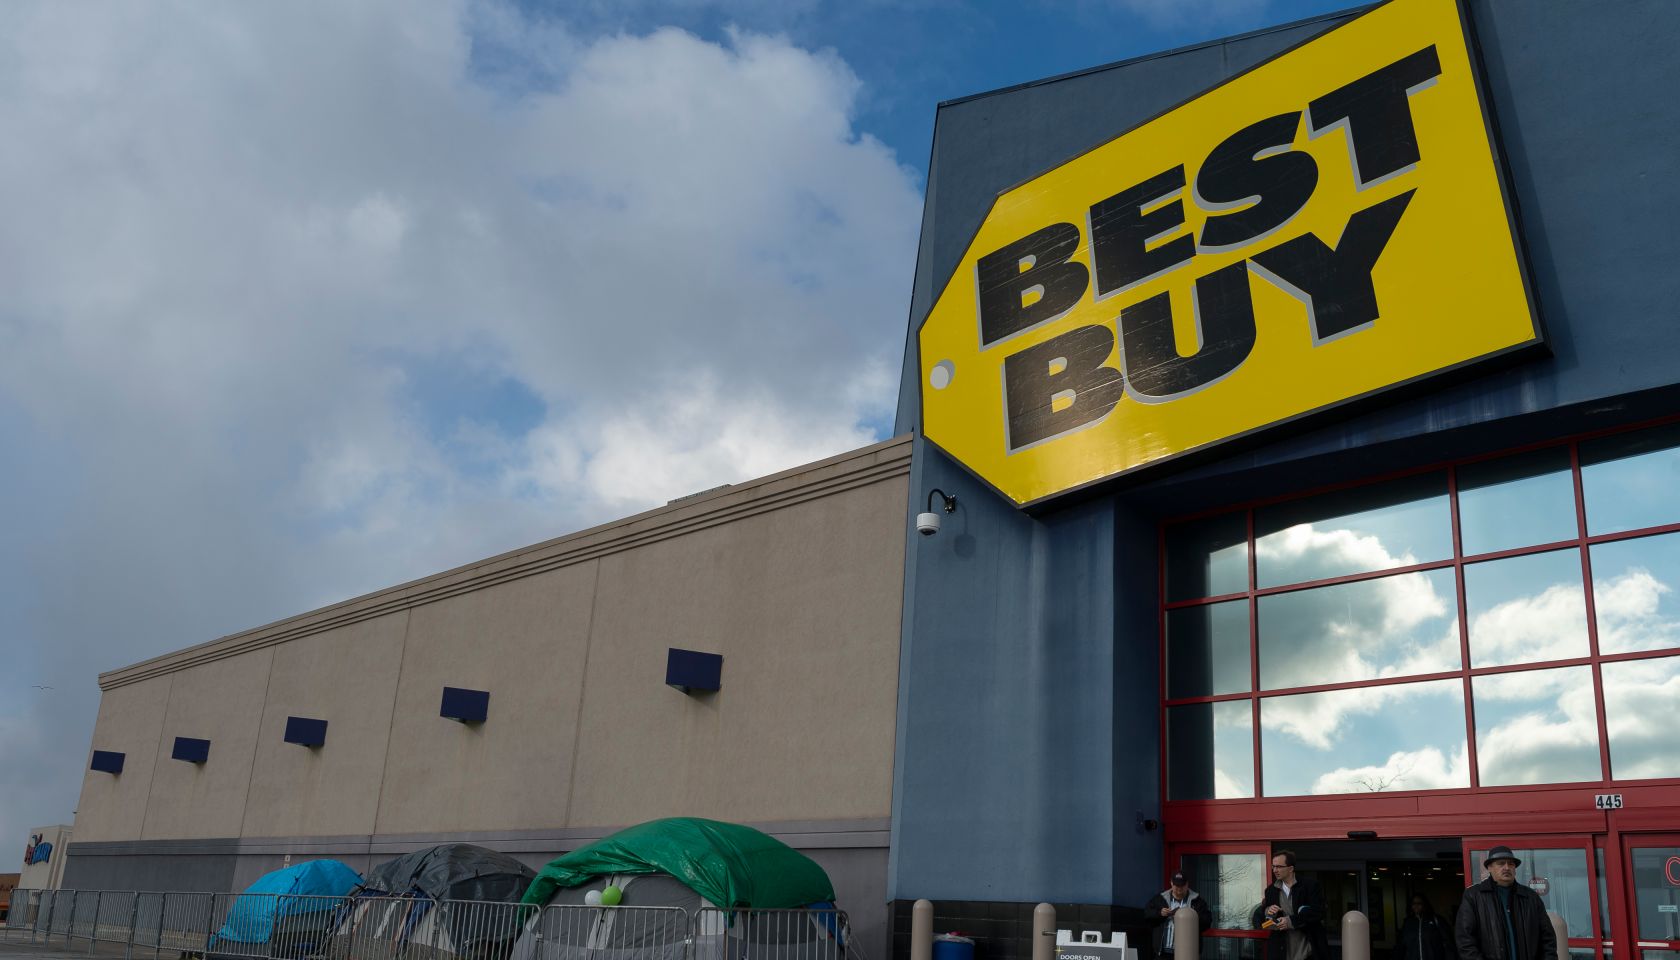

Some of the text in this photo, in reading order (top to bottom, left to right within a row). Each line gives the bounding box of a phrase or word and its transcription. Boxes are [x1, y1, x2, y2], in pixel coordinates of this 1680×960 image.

[974, 43, 1442, 351] BEST
[1001, 187, 1418, 455] BUY
[1597, 795, 1621, 808] 445
